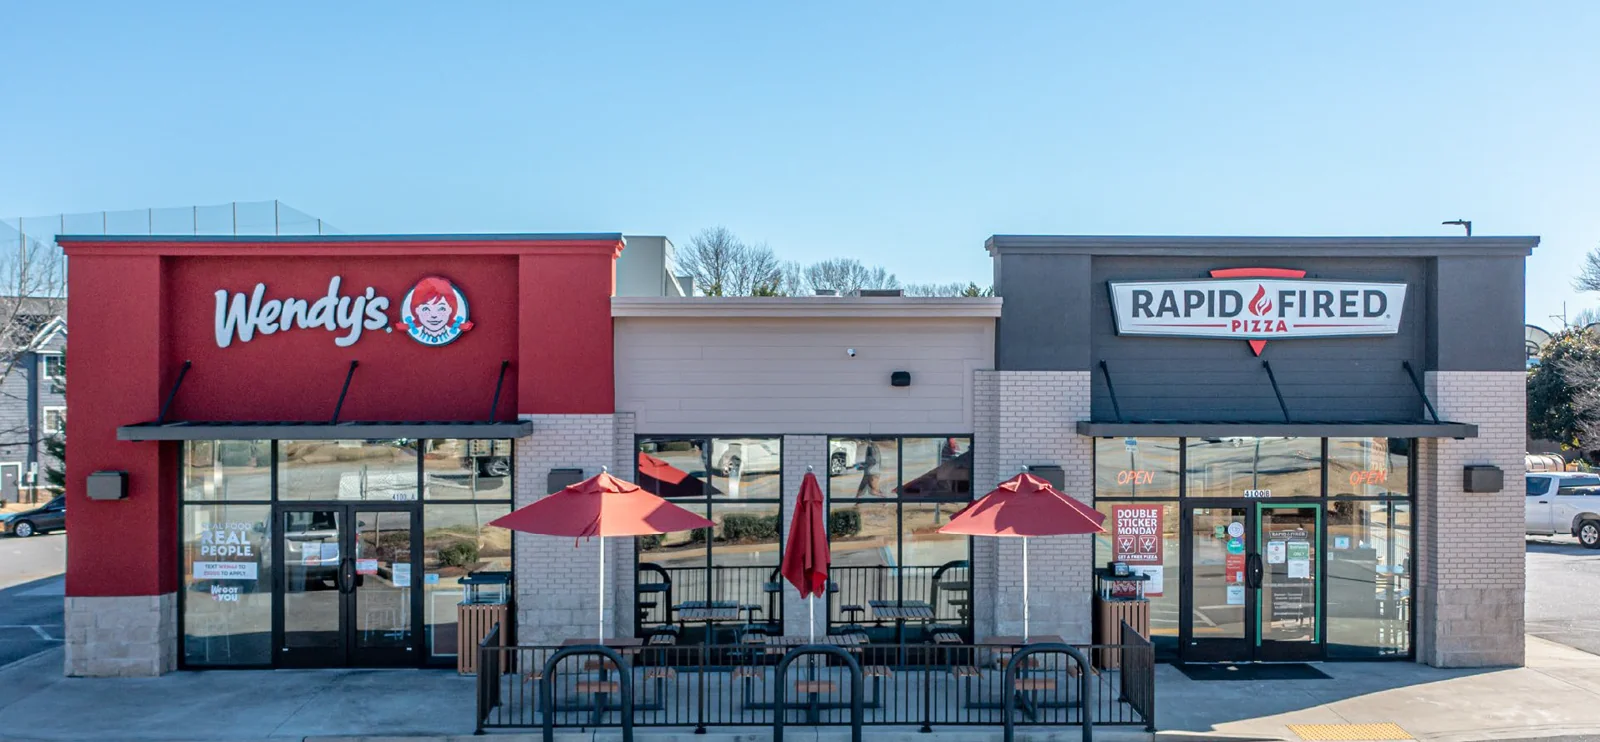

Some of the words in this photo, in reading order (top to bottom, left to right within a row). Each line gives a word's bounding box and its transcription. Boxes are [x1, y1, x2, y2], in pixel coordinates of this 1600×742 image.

[1131, 289, 1243, 318] RAPID
[1278, 289, 1387, 318] FIRED
[215, 275, 390, 348] Wendy's
[1231, 319, 1288, 333] PIZZA
[1117, 469, 1155, 485] OPEN
[1350, 470, 1387, 486] OPEN
[1117, 509, 1158, 519] DOUBLE
[1117, 518, 1158, 528] STICKER
[201, 531, 251, 545] REAL
[1117, 527, 1157, 535] MONDAY
[201, 545, 255, 557] PEOPLE.
[218, 594, 238, 602] YOU
